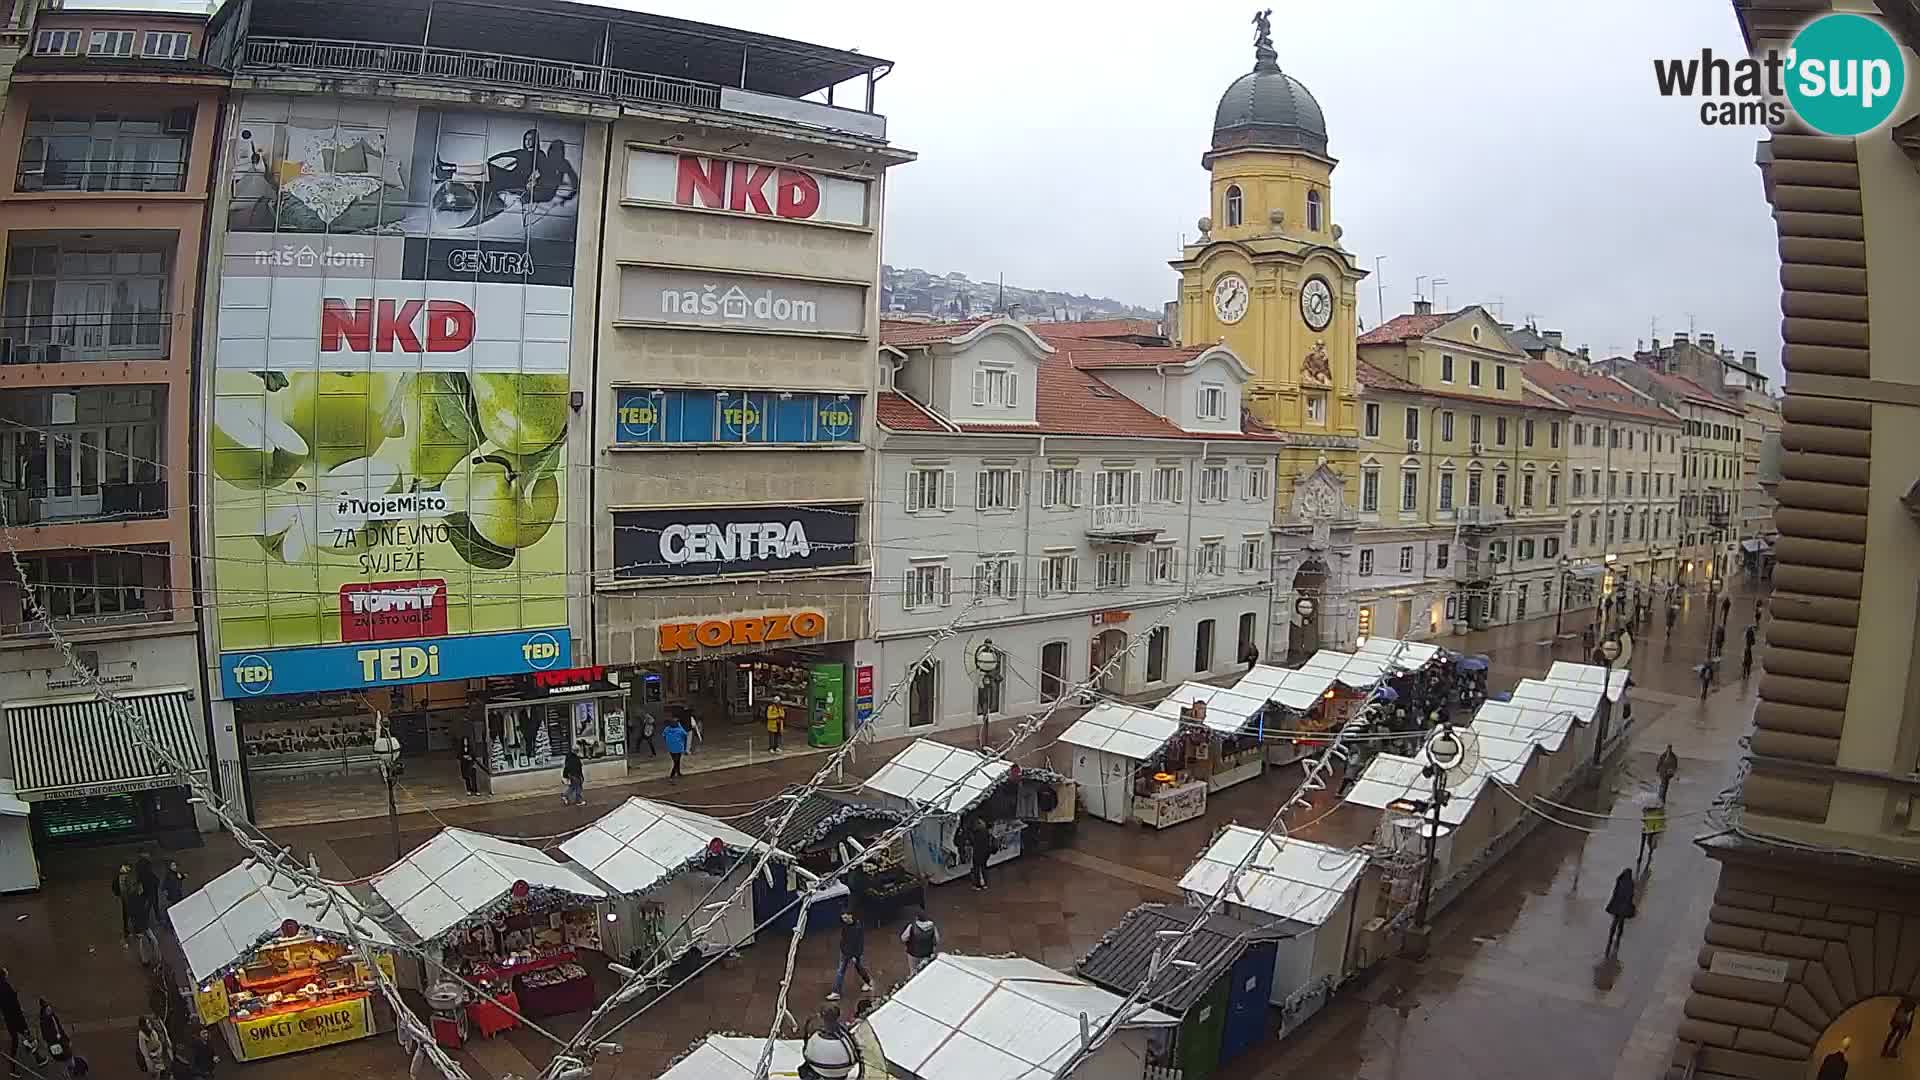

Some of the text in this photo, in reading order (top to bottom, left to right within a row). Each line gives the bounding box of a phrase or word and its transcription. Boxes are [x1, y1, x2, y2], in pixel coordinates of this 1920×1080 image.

[675, 155, 821, 220] NKD
[254, 245, 367, 268] naš dom
[447, 249, 535, 275] CENTRA
[660, 283, 817, 322] naš dom
[320, 297, 477, 353] NKD
[618, 407, 658, 425] TEDi
[819, 410, 853, 427] TEDi
[337, 496, 446, 516] #TvojeMisto
[333, 523, 450, 548] ZA DNEVNO
[658, 520, 811, 564] CENTRA
[359, 546, 425, 575] SVJEŽE
[658, 611, 826, 653] KORZO
[358, 645, 440, 682] TEDi
[522, 643, 560, 662] TEDi
[233, 665, 273, 685] TEDi
[249, 1021, 292, 1041] SWEET
